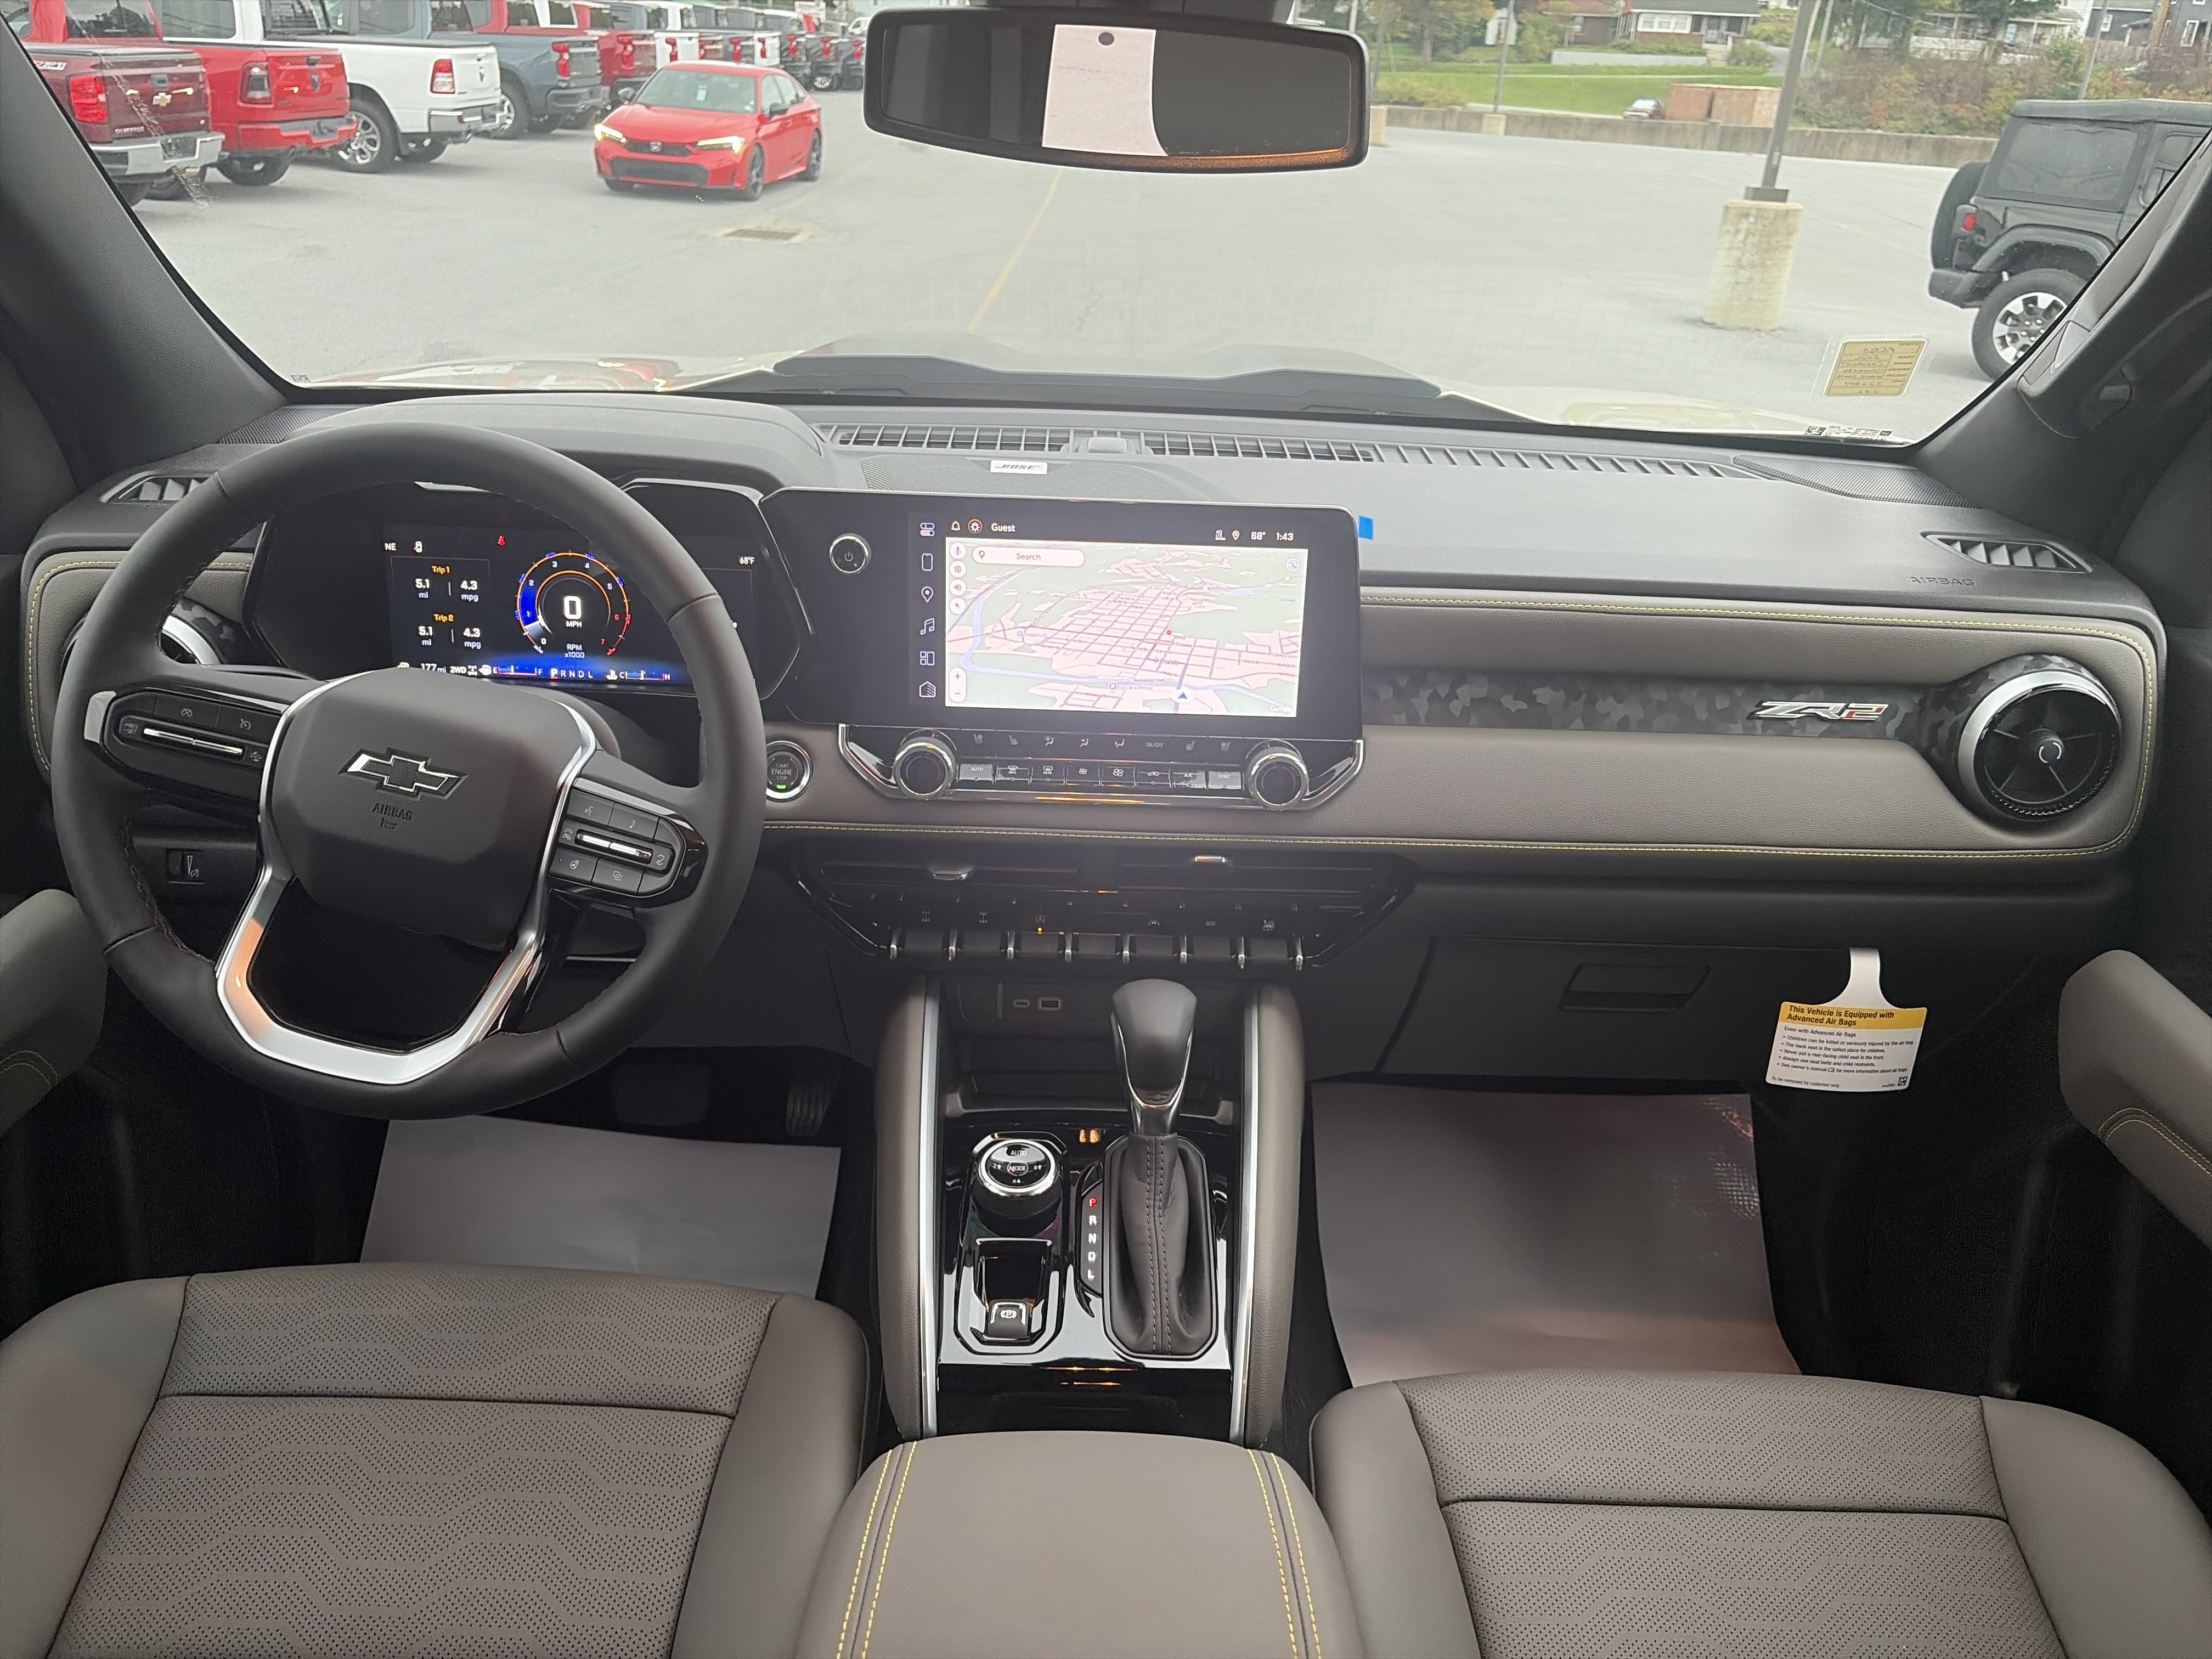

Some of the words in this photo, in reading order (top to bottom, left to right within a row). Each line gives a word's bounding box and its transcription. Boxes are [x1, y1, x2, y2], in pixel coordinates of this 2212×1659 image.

[991, 523, 1016, 532] Guest
[1276, 532, 1294, 541] 1:43
[385, 543, 397, 551] NE
[431, 566, 445, 574] Trip
[415, 578, 430, 589] 5.1
[460, 580, 478, 590] 4.3
[1910, 577, 1974, 586] AIRBAG
[461, 594, 479, 602] mpg
[564, 596, 582, 619] 0
[433, 613, 448, 623] Trip
[418, 625, 433, 636] 5.1
[463, 628, 481, 637] 4.3
[464, 641, 482, 650] mpg
[420, 663, 437, 672] 177
[551, 668, 558, 677] P
[1750, 701, 1889, 721] ZR2
[372, 803, 413, 820] AIRBAG
[1789, 1005, 1804, 1013] This
[1807, 1007, 1834, 1016] Vehicle
[1836, 1009, 1842, 1017] is
[1844, 1011, 1878, 1019] Equipped
[1786, 1013, 1825, 1024] Advanced
[1089, 1198, 1097, 1207] P
[1089, 1215, 1097, 1225] R
[1088, 1233, 1097, 1243] N
[1087, 1251, 1096, 1261] D
[1087, 1269, 1094, 1279] L
